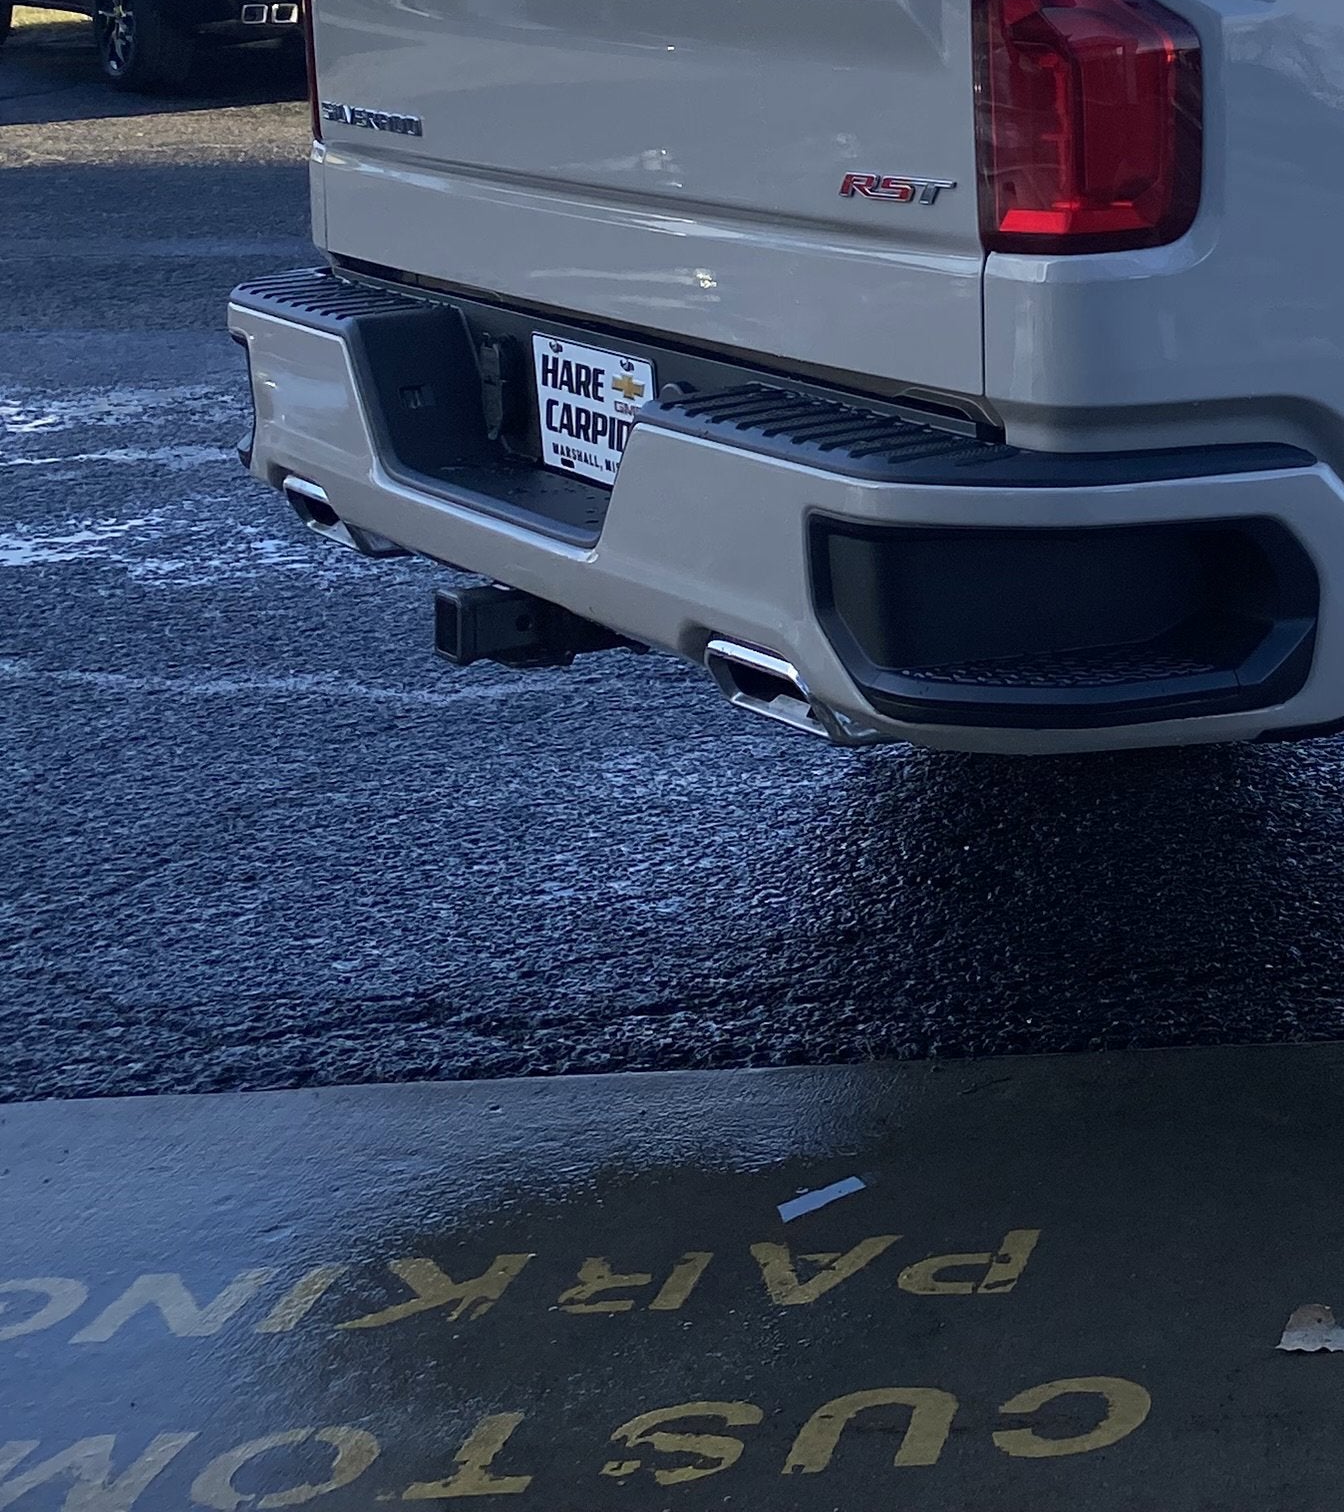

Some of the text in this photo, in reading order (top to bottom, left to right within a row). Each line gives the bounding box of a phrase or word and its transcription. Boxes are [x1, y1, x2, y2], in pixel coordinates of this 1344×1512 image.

[840, 171, 957, 205] RST
[541, 354, 605, 403] HARE
[552, 442, 604, 472] MARSHALL,
